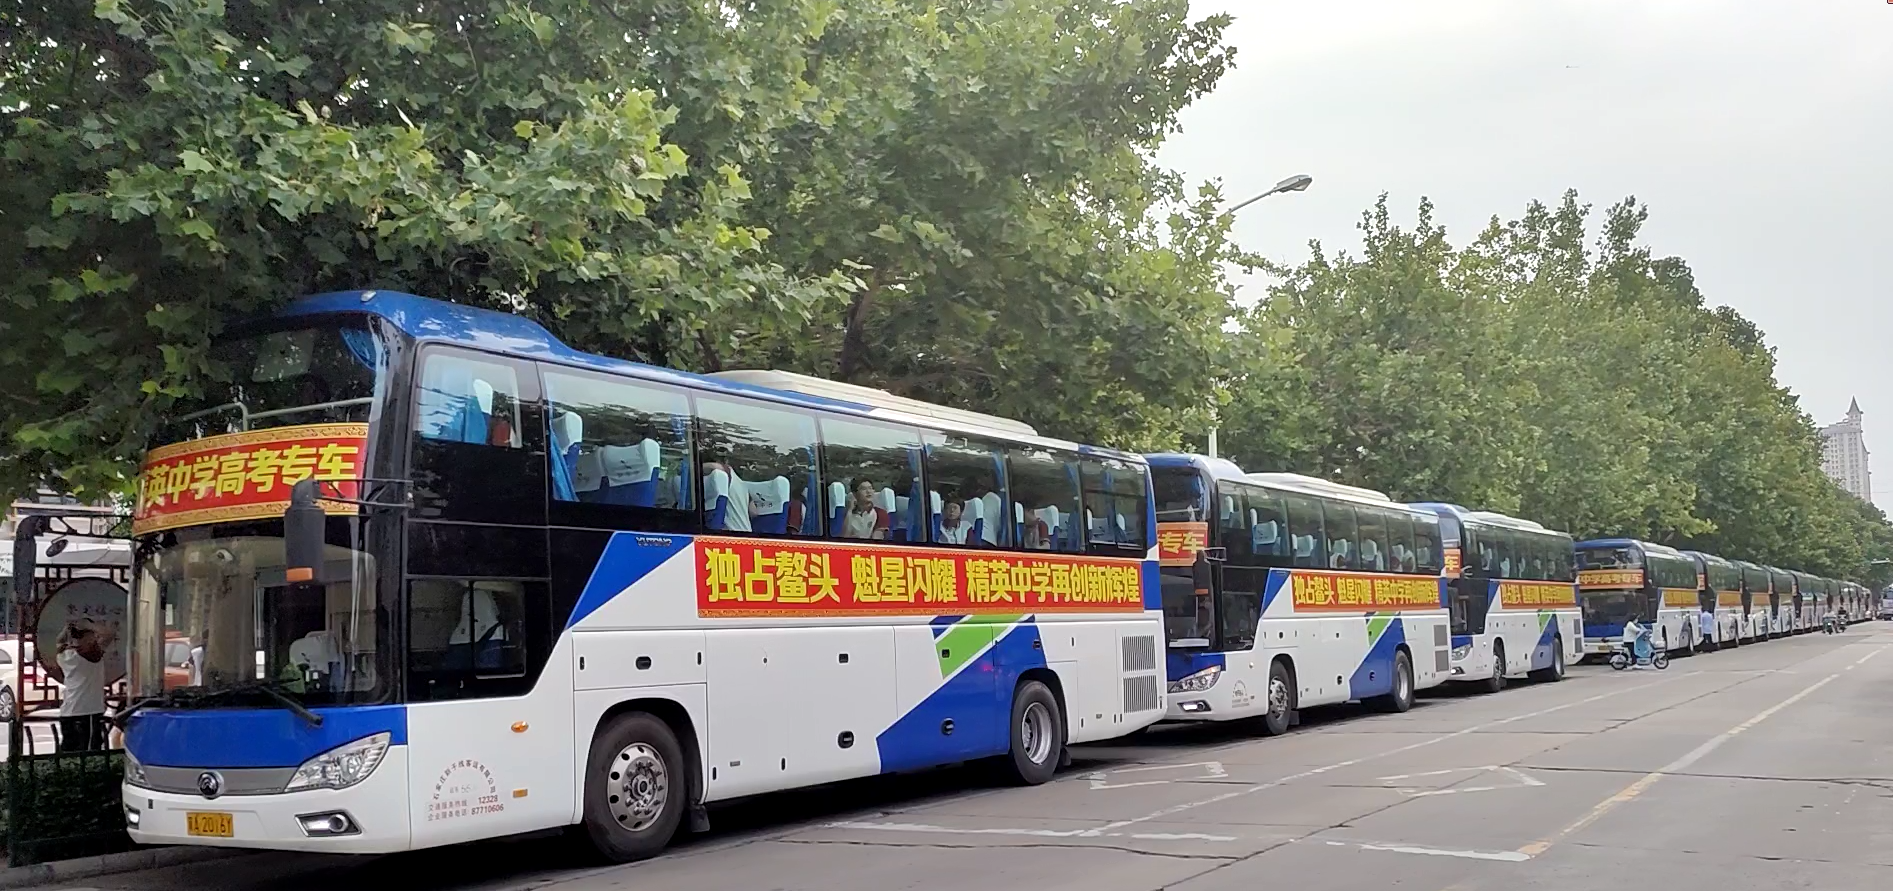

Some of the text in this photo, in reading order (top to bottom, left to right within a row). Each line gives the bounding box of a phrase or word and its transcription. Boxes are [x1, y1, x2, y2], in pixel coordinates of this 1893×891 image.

[142, 443, 359, 509] 英中学高考专车
[1157, 531, 1205, 555] 专车
[704, 547, 1141, 603] 独占鳌头 魁星闪耀 精英中学再创新辉煌
